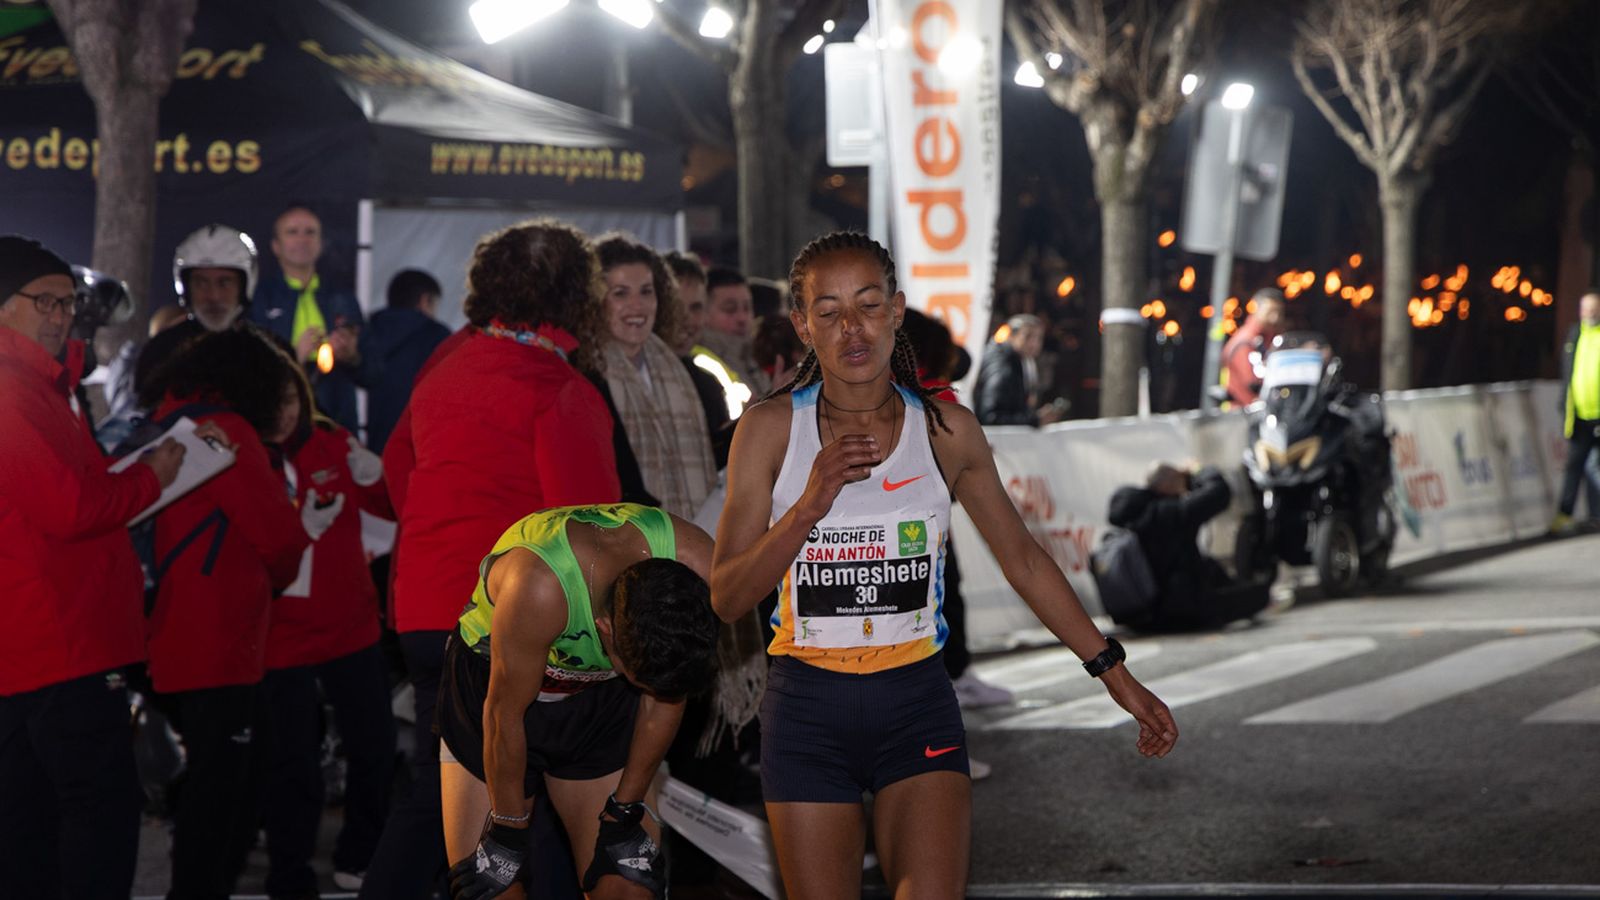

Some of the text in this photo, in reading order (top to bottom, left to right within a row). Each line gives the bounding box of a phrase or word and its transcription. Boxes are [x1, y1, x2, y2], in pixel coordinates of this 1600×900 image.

[822, 531, 866, 544] NOCHE
[869, 530, 886, 543] DE
[806, 547, 835, 562] SAN
[837, 543, 886, 561] ANTÓN
[797, 559, 929, 587] Alemeshete
[855, 586, 878, 605] 30
[835, 605, 898, 614] Mekedes Alemeshete
